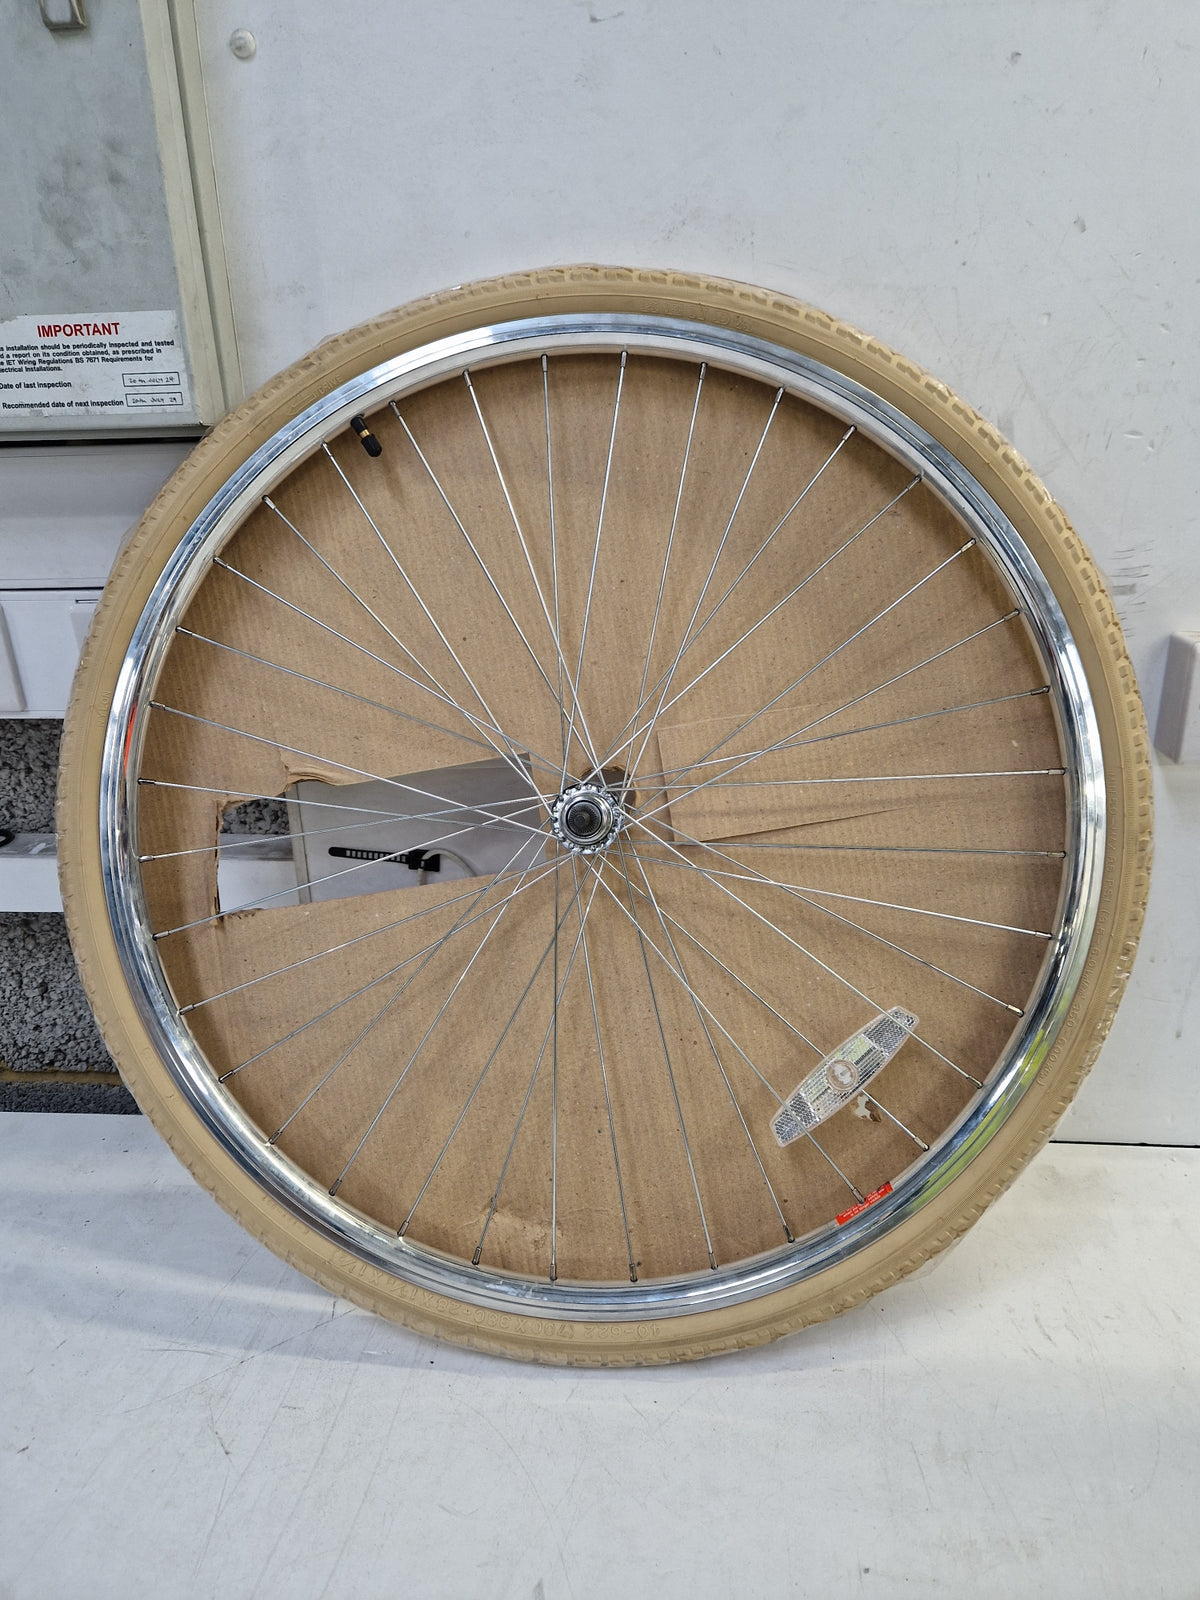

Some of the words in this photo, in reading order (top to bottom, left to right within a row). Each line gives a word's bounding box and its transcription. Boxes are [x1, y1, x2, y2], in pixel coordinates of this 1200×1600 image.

[37, 322, 120, 338] IMPORTANT
[6, 344, 39, 352] installation
[72, 341, 107, 350] periodically
[108, 341, 139, 349] inspected
[154, 339, 175, 347] tested
[12, 352, 30, 360] report
[82, 349, 110, 357] obtained,
[121, 348, 154, 356] prescribed
[17, 359, 37, 367] Wiring
[38, 357, 74, 366] Regulations
[37, 381, 72, 389] inspection
[2, 401, 50, 409] Recommended
[67, 400, 74, 408] of
[75, 400, 89, 408] next
[90, 399, 124, 408] inspection
[583, 1322, 661, 1339] 40-622
